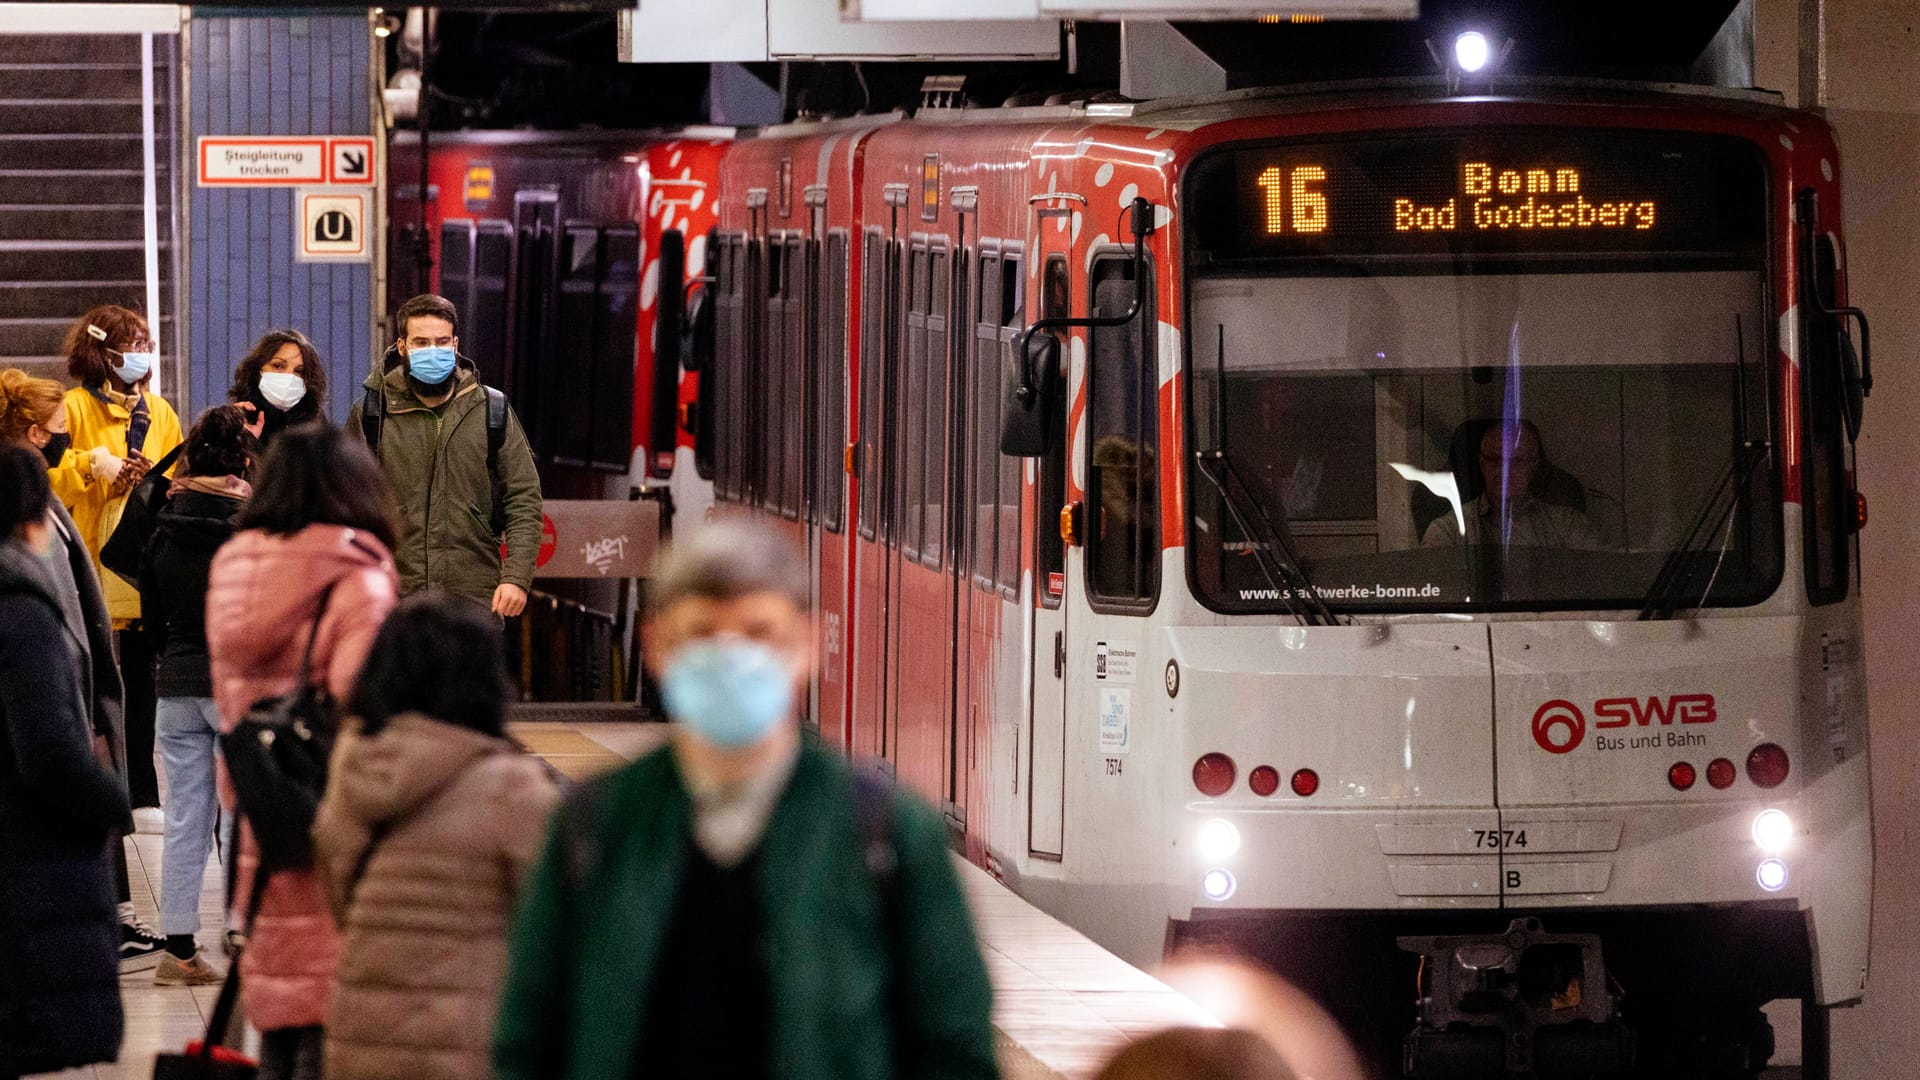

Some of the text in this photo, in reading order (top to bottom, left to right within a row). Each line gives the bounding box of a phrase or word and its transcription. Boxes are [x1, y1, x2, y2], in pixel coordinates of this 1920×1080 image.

[225, 150, 303, 164] Steigleitung
[240, 165, 289, 176] trocken
[1465, 163, 1579, 195] Bonn
[1258, 166, 1327, 234] 16
[1395, 196, 1655, 230] Bad Godesberg
[1240, 583, 1441, 600] www.satwerke-bonn.de
[1594, 694, 1717, 729] SWB
[1596, 731, 1707, 751] Bus und Bahn
[1105, 758, 1122, 776] 7574
[1474, 830, 1528, 848] 7574
[1506, 870, 1522, 888] B
